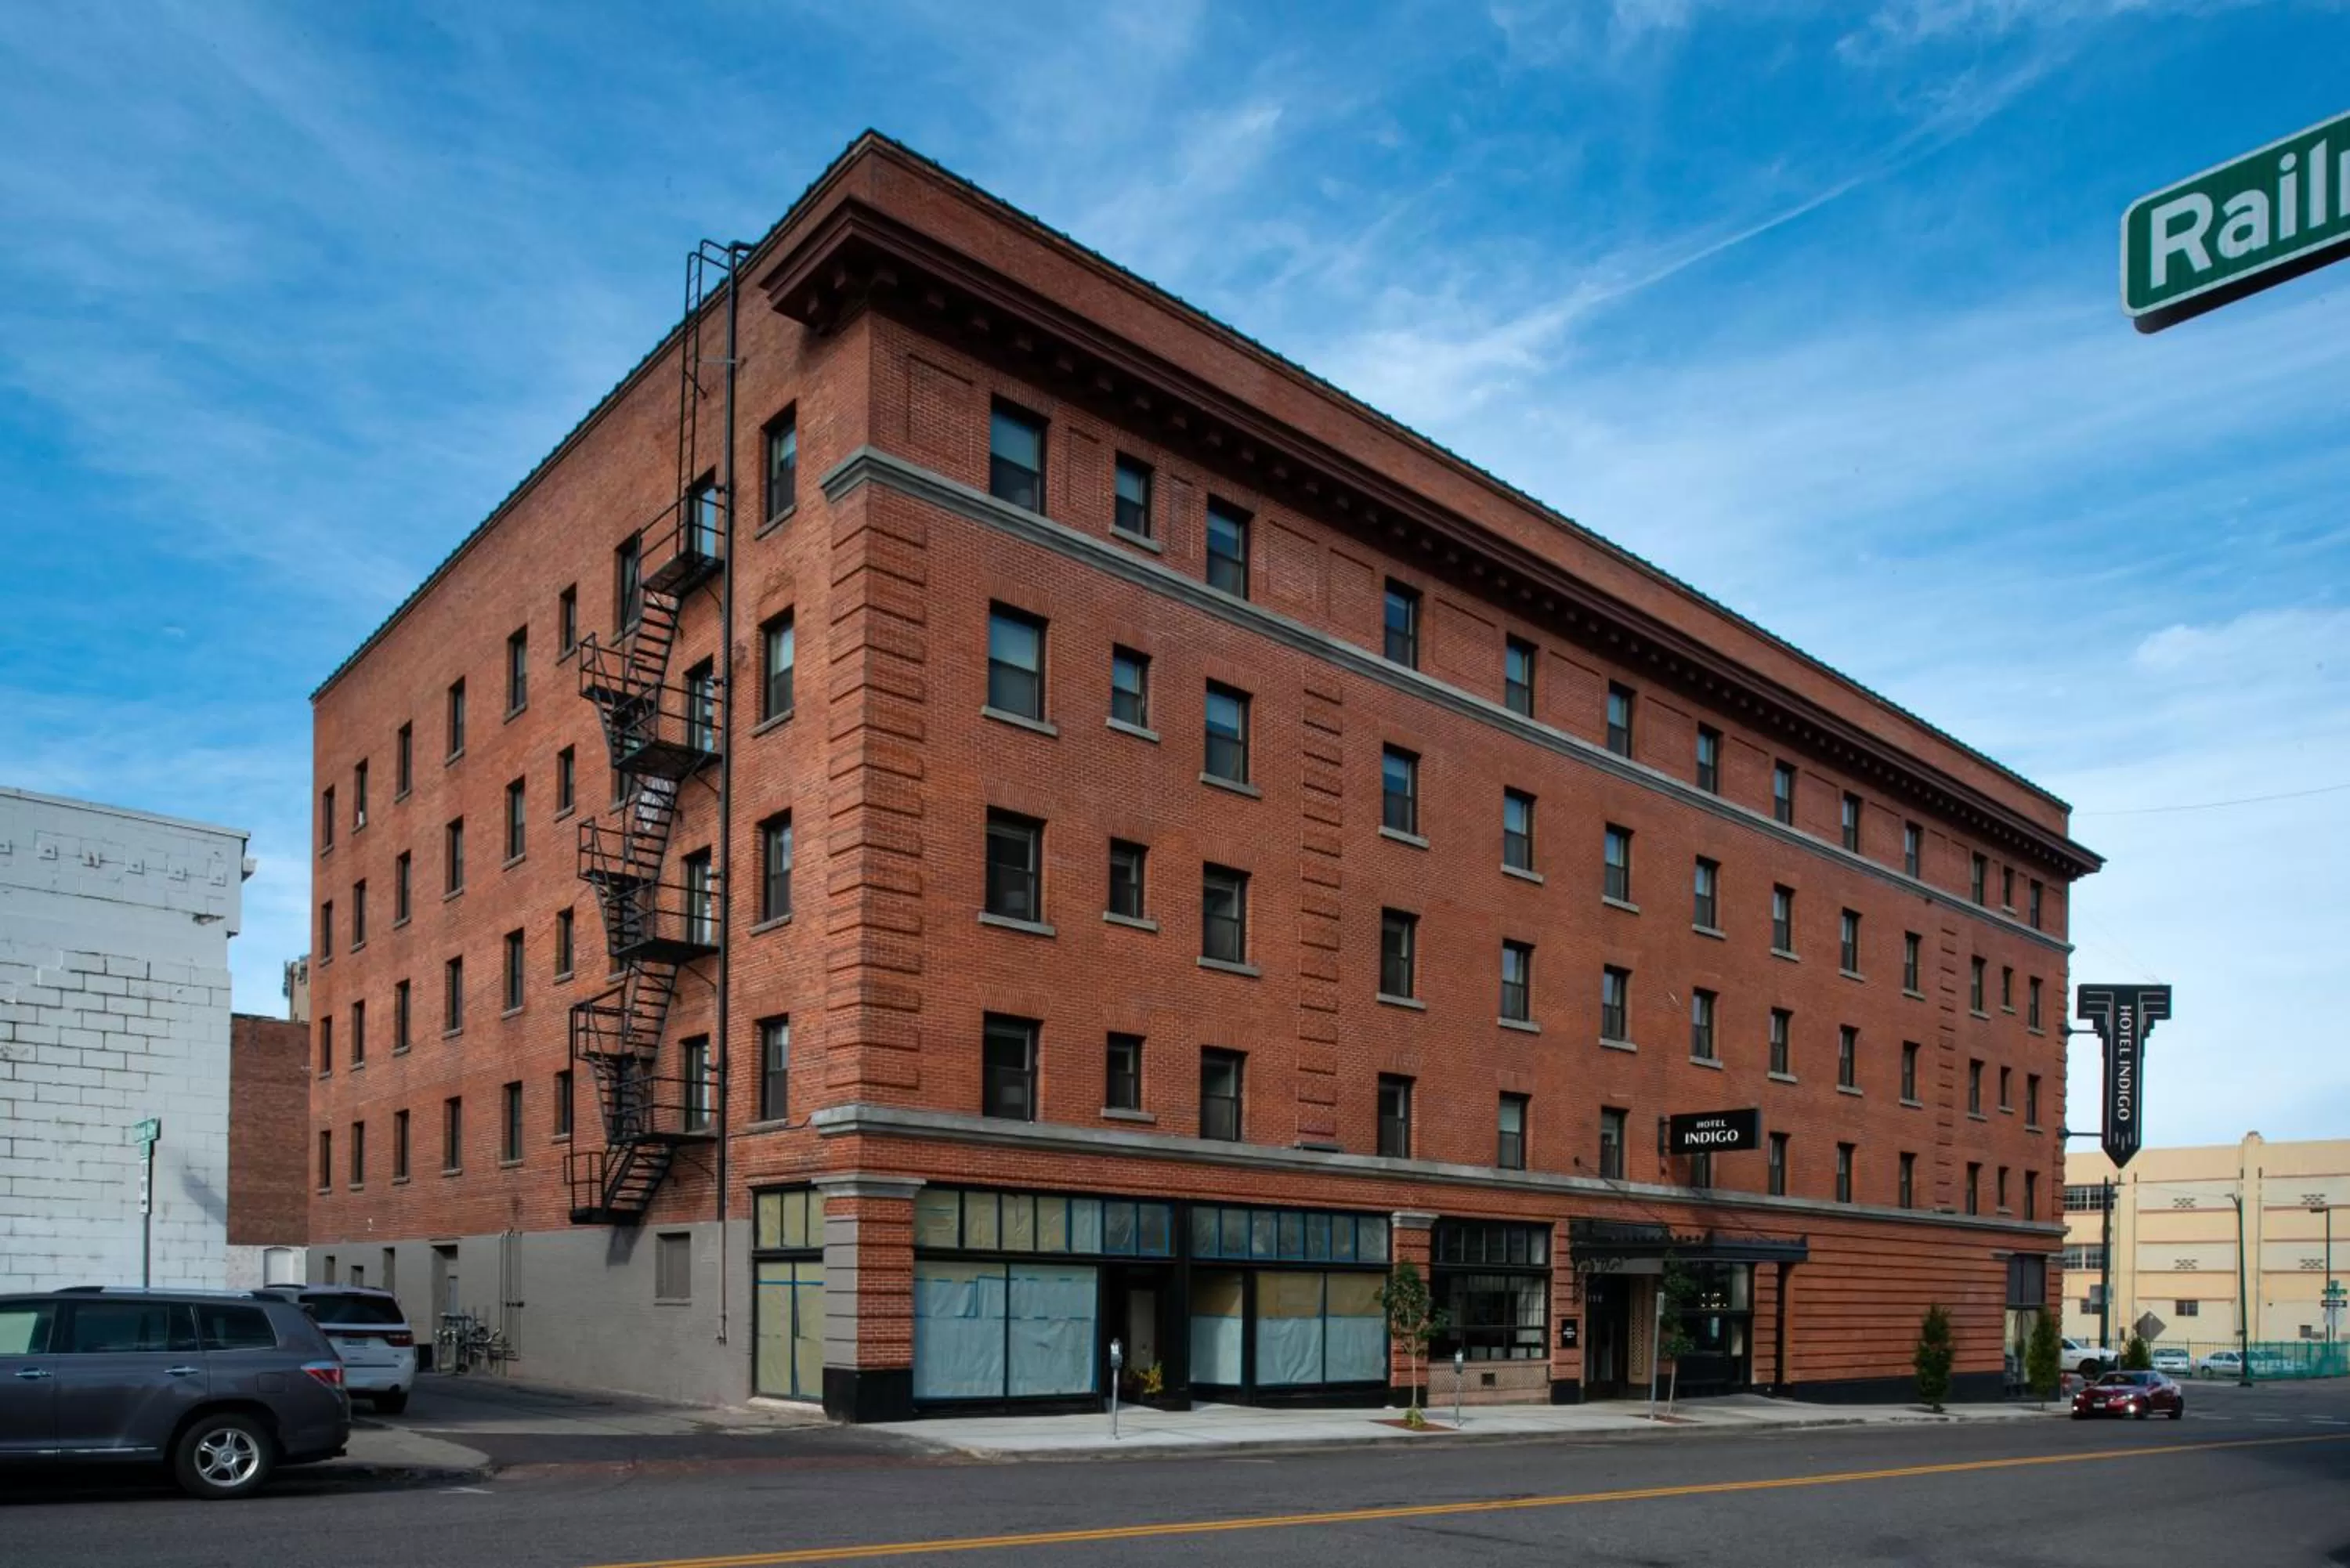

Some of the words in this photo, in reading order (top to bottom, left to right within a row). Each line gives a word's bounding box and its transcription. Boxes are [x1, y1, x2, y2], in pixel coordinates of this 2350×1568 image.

[2119, 1005, 2132, 1055] HOTEL
[2117, 1060, 2131, 1121] INDIGO
[1685, 1129, 1739, 1144] INDIGO
[1697, 1119, 1727, 1129] HOTEL
